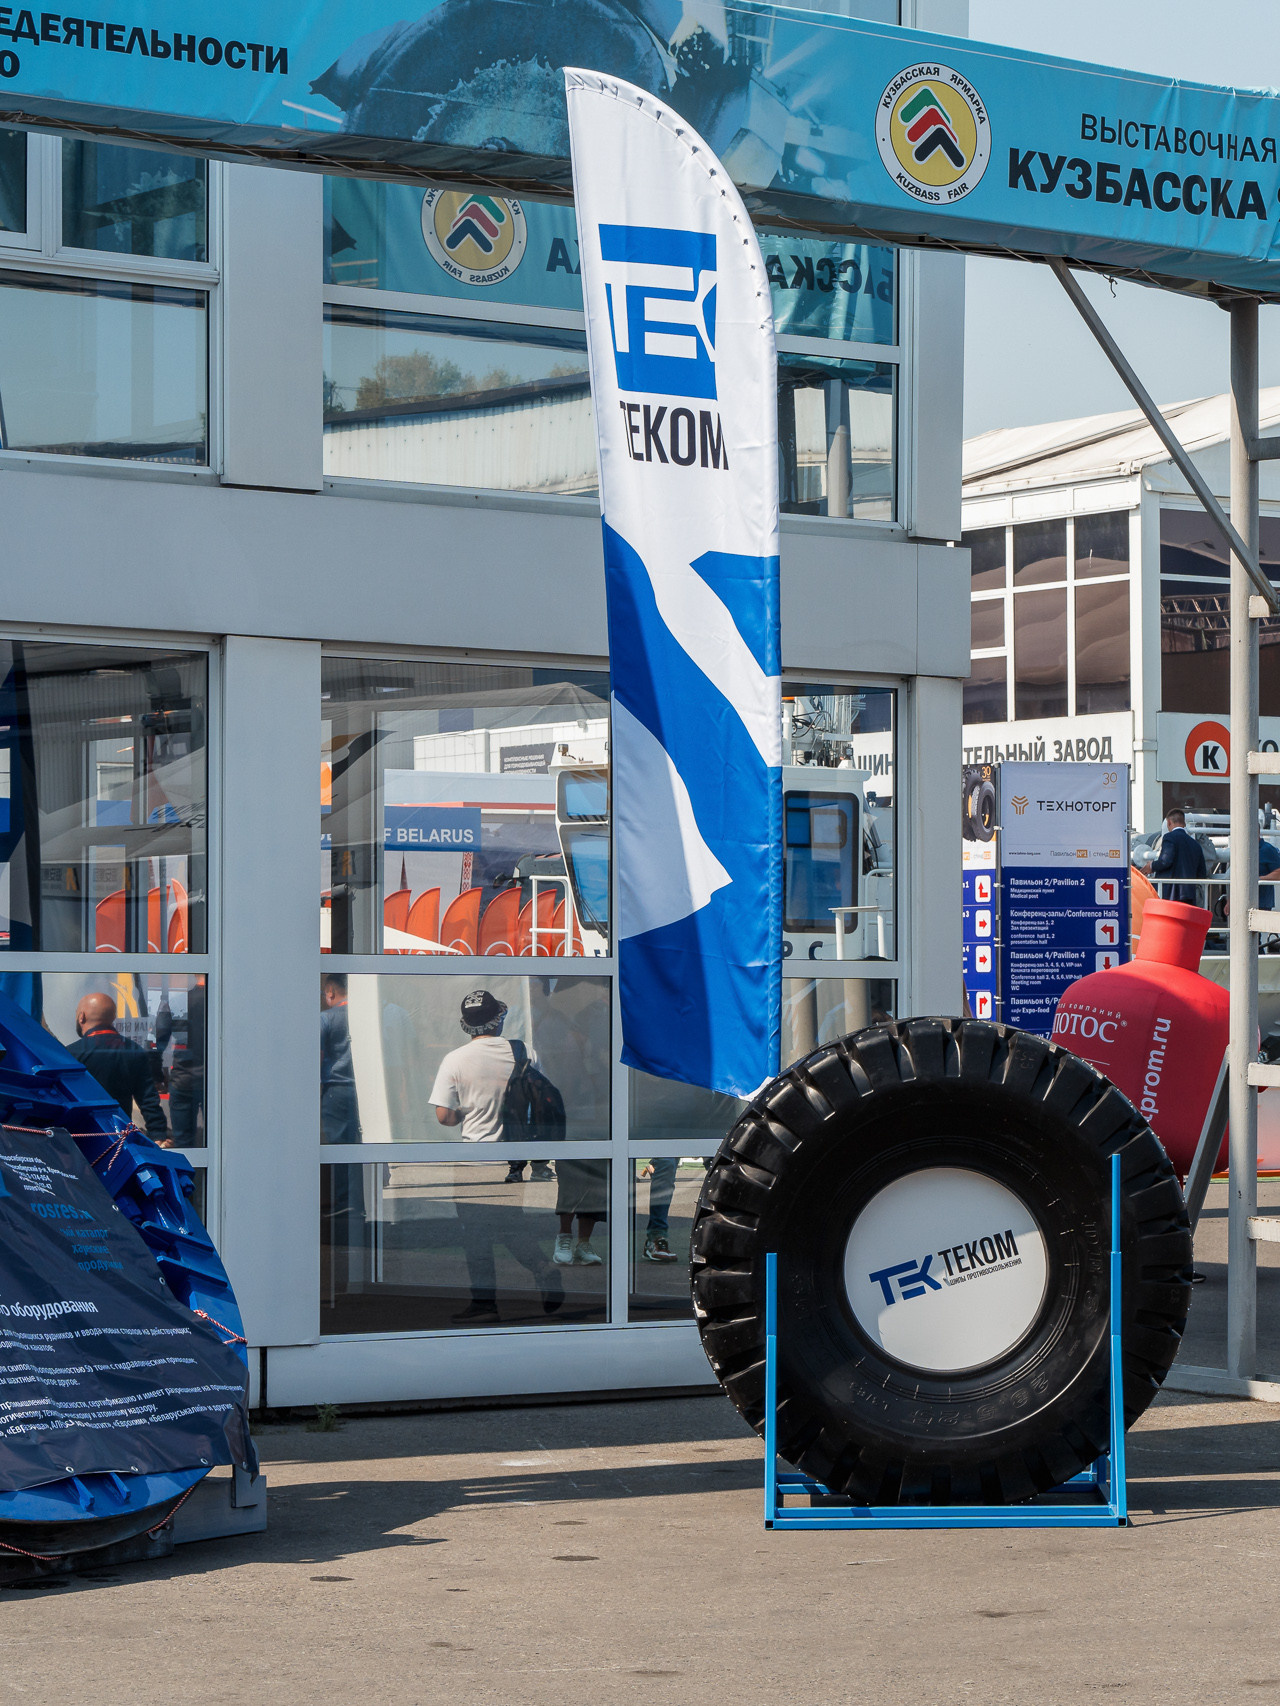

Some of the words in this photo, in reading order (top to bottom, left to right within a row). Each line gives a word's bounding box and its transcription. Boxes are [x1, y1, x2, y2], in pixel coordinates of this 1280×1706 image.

[882, 67, 940, 108] КУЗБАССКАЯ
[950, 74, 986, 124] ЯРМАРКА
[1081, 113, 1274, 163] ВЫСТАВОЧНАЯ
[896, 172, 940, 201] KUZBASS
[947, 182, 969, 199] FAIR
[1008, 147, 1268, 221] КУЗБАССКА
[1053, 736, 1113, 763] ЗАВОД
[1202, 745, 1220, 770] К
[1036, 800, 1117, 812] ТЕХНОТОРГ
[397, 828, 474, 843] BELARUS
[1050, 850, 1076, 858] Павильон
[1010, 878, 1043, 887] Павильон
[1044, 878, 1079, 887] 2/Pavilion
[1080, 878, 1085, 886] 2
[1103, 910, 1119, 918] Halls
[1010, 951, 1043, 960] Павильон
[1044, 951, 1079, 960] 4/Pavilion
[1080, 951, 1086, 959] 4
[1010, 997, 1044, 1006] Павильон
[1068, 1003, 1121, 1020] компаний
[937, 1229, 1020, 1277] ТЕКОМ
[10, 1301, 99, 1321] оборудования
[81, 1328, 102, 1337] ввода
[144, 1389, 165, 1400] имеет
[128, 1403, 159, 1416] надзору.
